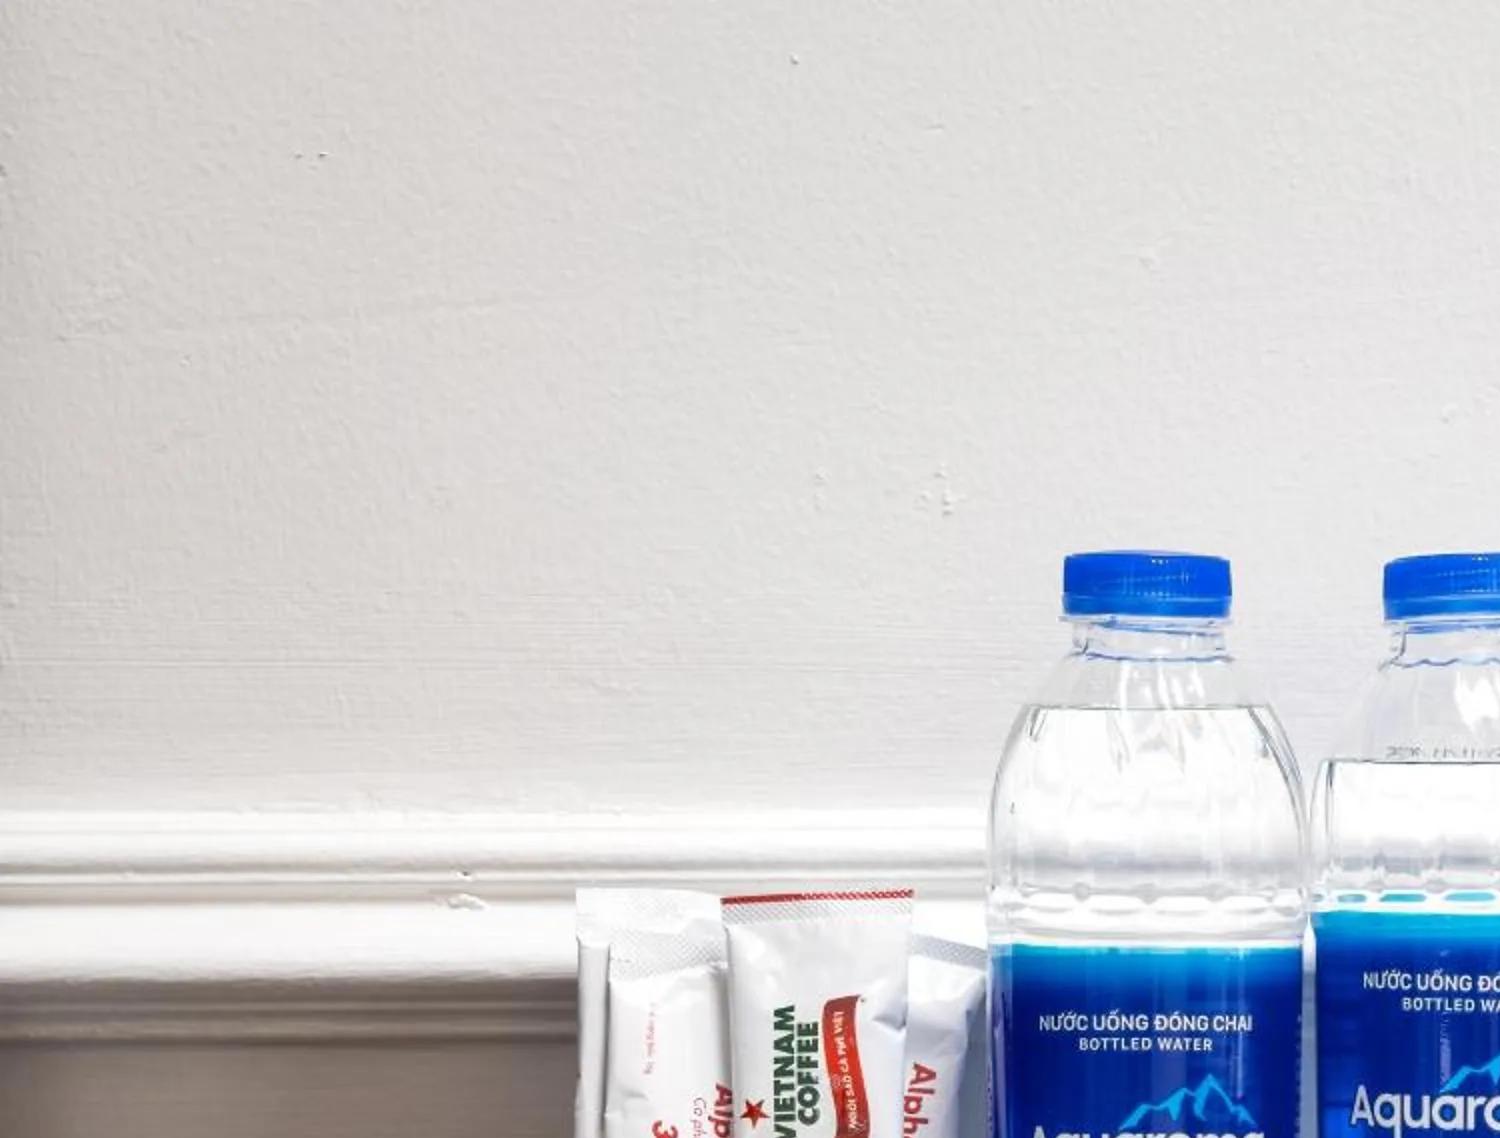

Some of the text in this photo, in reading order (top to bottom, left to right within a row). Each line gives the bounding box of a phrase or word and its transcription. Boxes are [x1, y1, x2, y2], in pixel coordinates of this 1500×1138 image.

[1363, 971, 1412, 990] NƯỚC
[1417, 968, 1473, 992] UỐNG
[1403, 998, 1475, 1012] BOTTLED
[1039, 1010, 1253, 1032] NƯỚC UỐNG ĐÓNG CHAI
[1079, 1037, 1213, 1051] BOTTLED WATER
[797, 1021, 820, 1126] COFFEE
